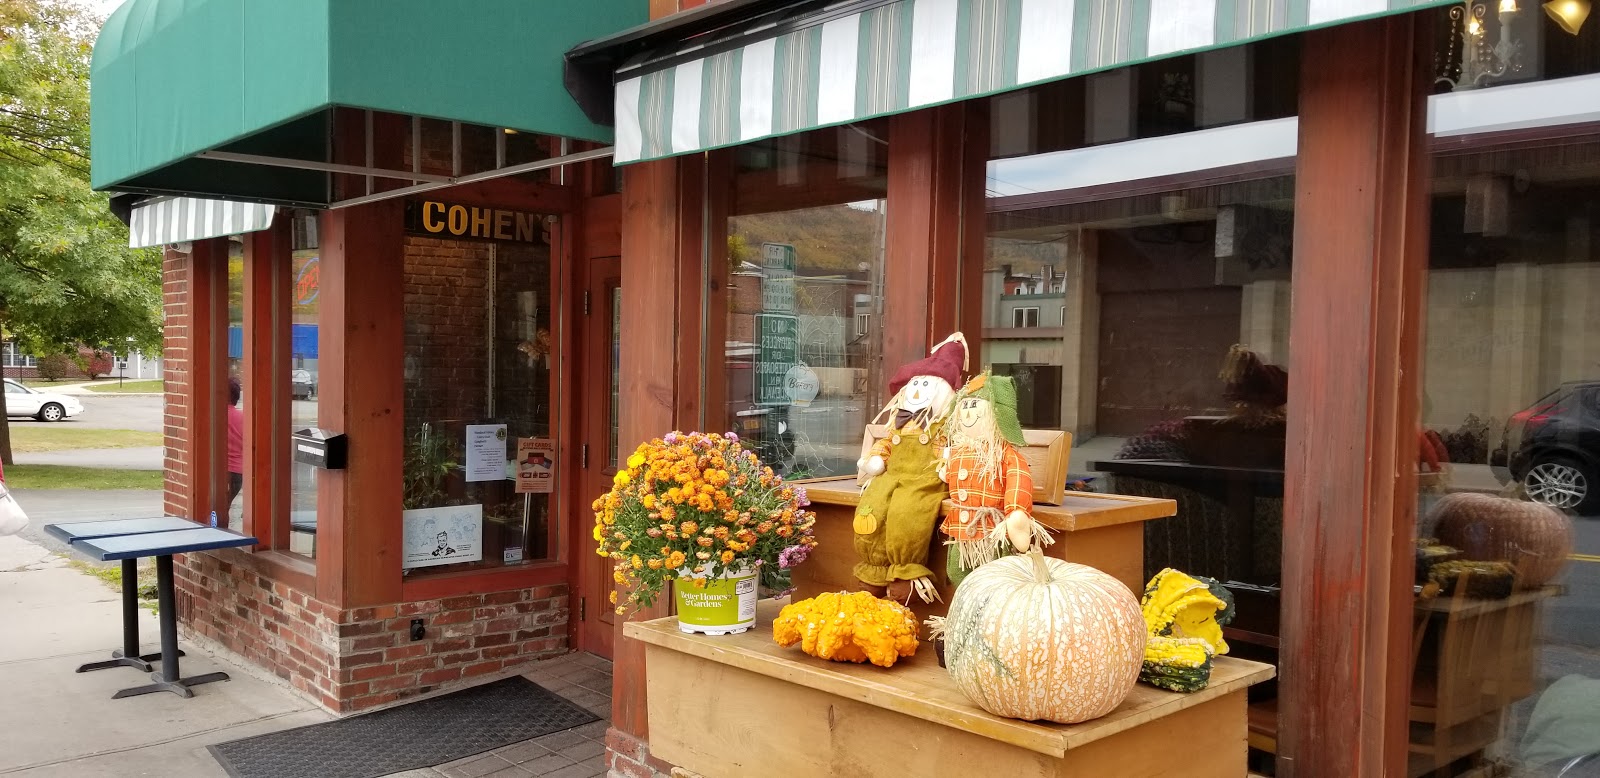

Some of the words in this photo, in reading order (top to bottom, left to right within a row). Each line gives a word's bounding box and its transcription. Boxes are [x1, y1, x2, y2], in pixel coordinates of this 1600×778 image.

[423, 201, 551, 245] COHEN'S
[680, 590, 699, 600] Better
[700, 593, 727, 601] Homes
